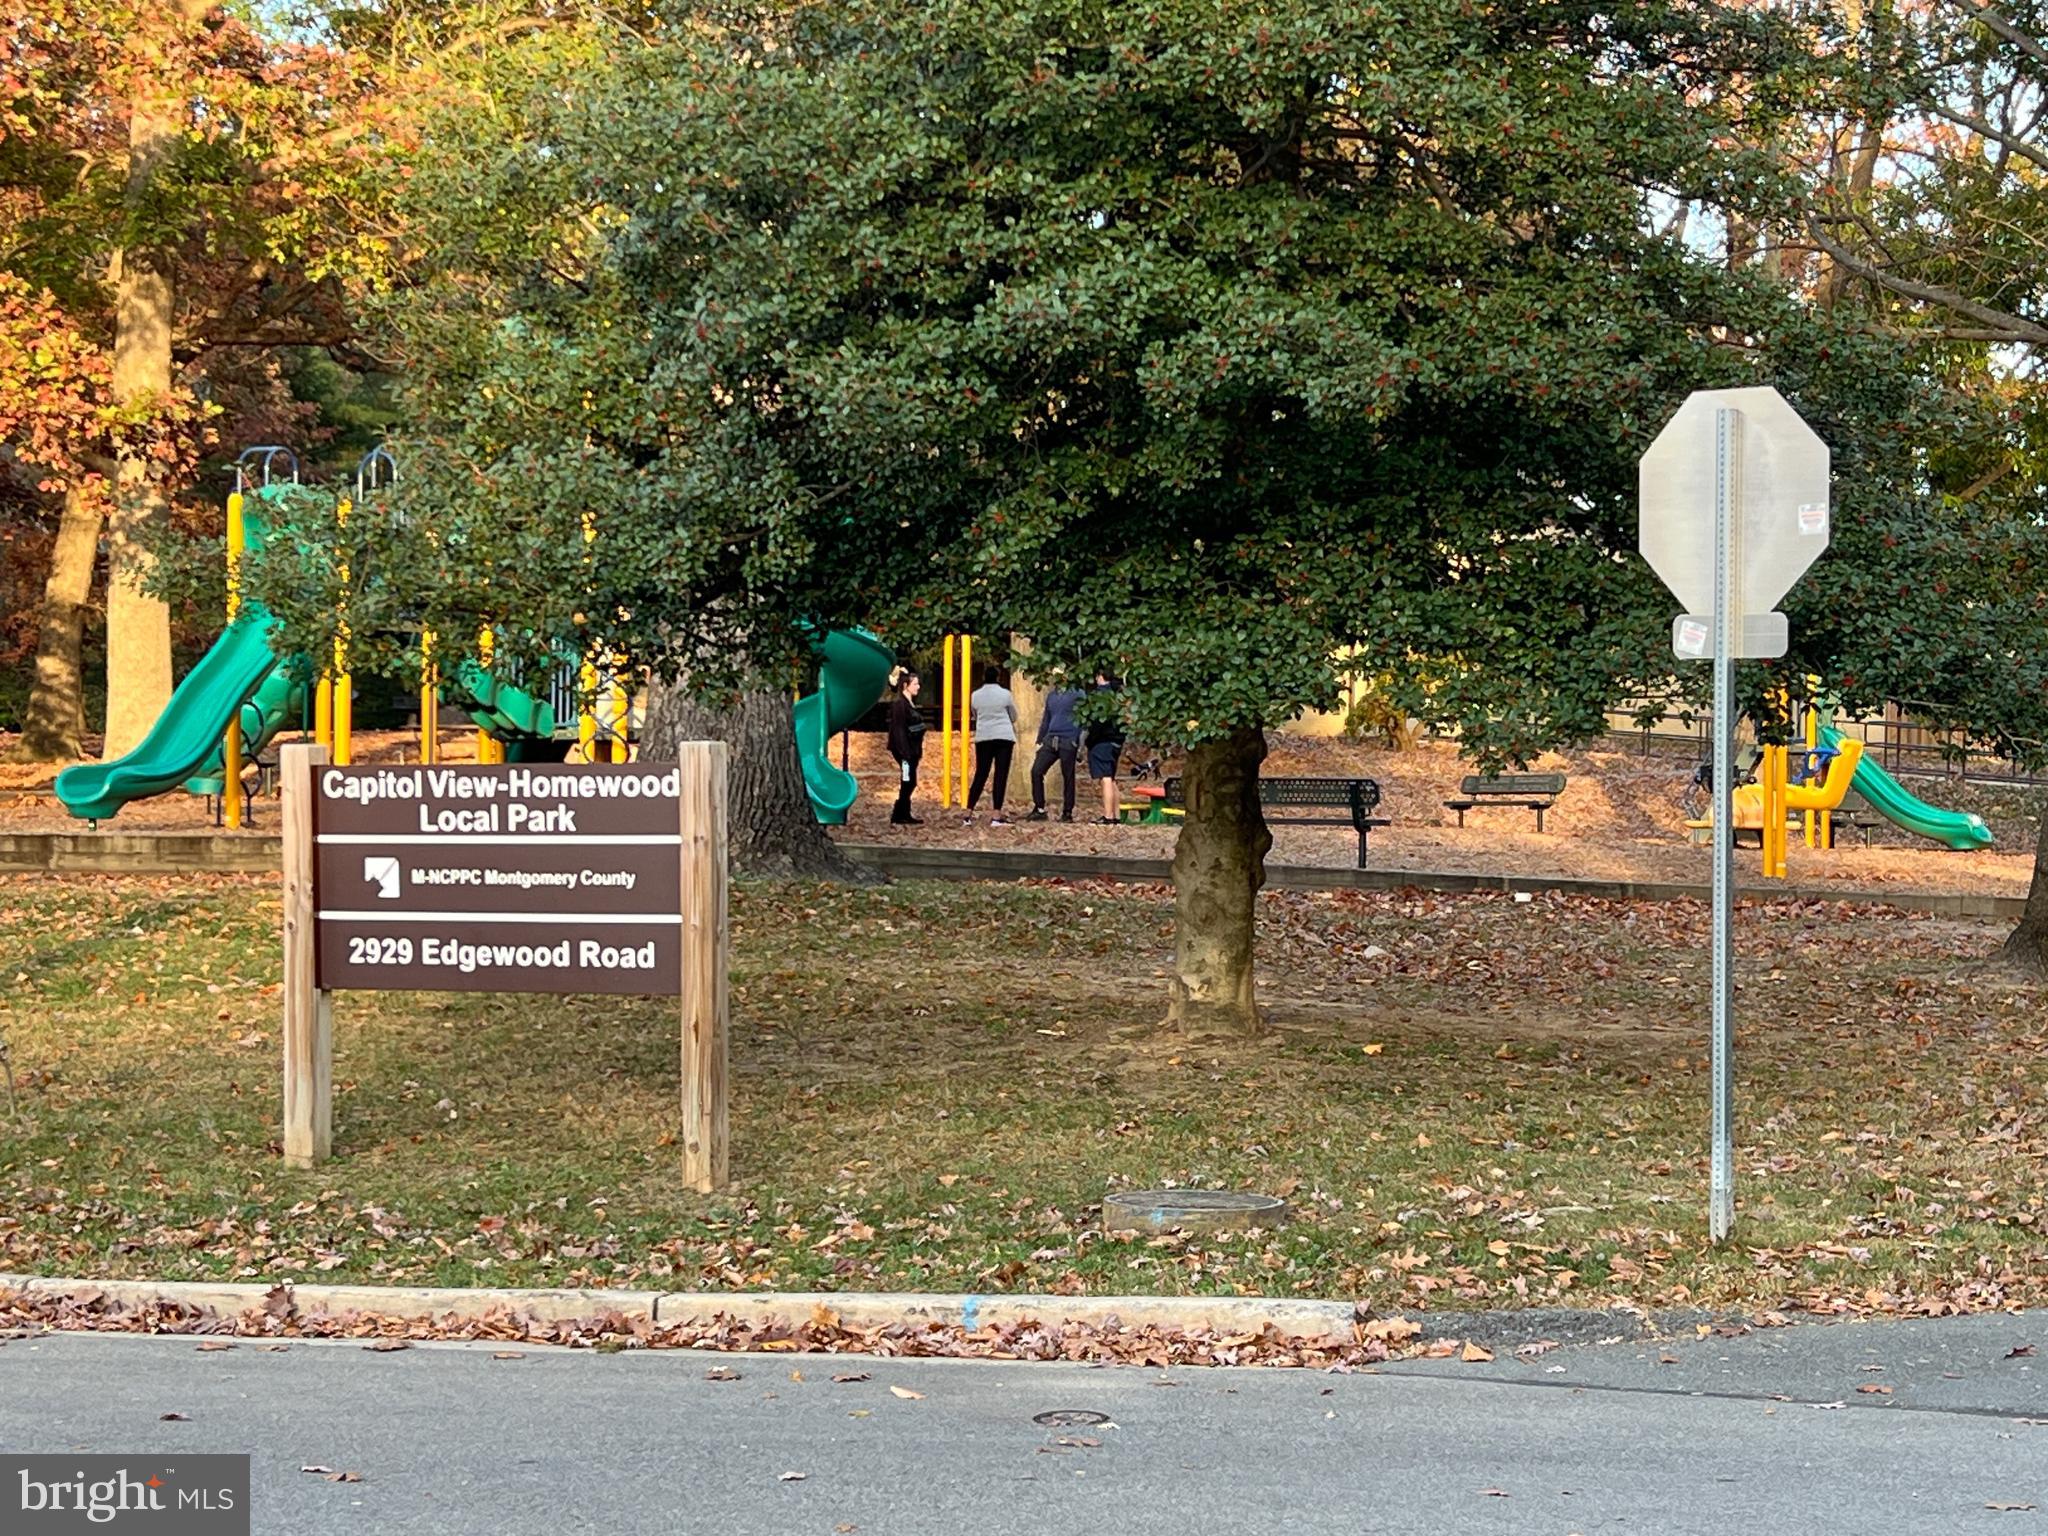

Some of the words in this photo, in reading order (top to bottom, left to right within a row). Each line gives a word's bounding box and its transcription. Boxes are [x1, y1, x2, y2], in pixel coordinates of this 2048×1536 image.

[322, 769, 422, 804] Capitol
[427, 768, 680, 799] View-Homewood
[420, 804, 498, 832] Local
[508, 803, 576, 832] Park
[411, 869, 481, 886] M-NCPPC
[485, 869, 577, 889] Montgomery
[581, 870, 636, 889] County
[349, 937, 413, 965] 2929
[422, 938, 570, 973] Edgewood
[580, 941, 655, 969] Road
